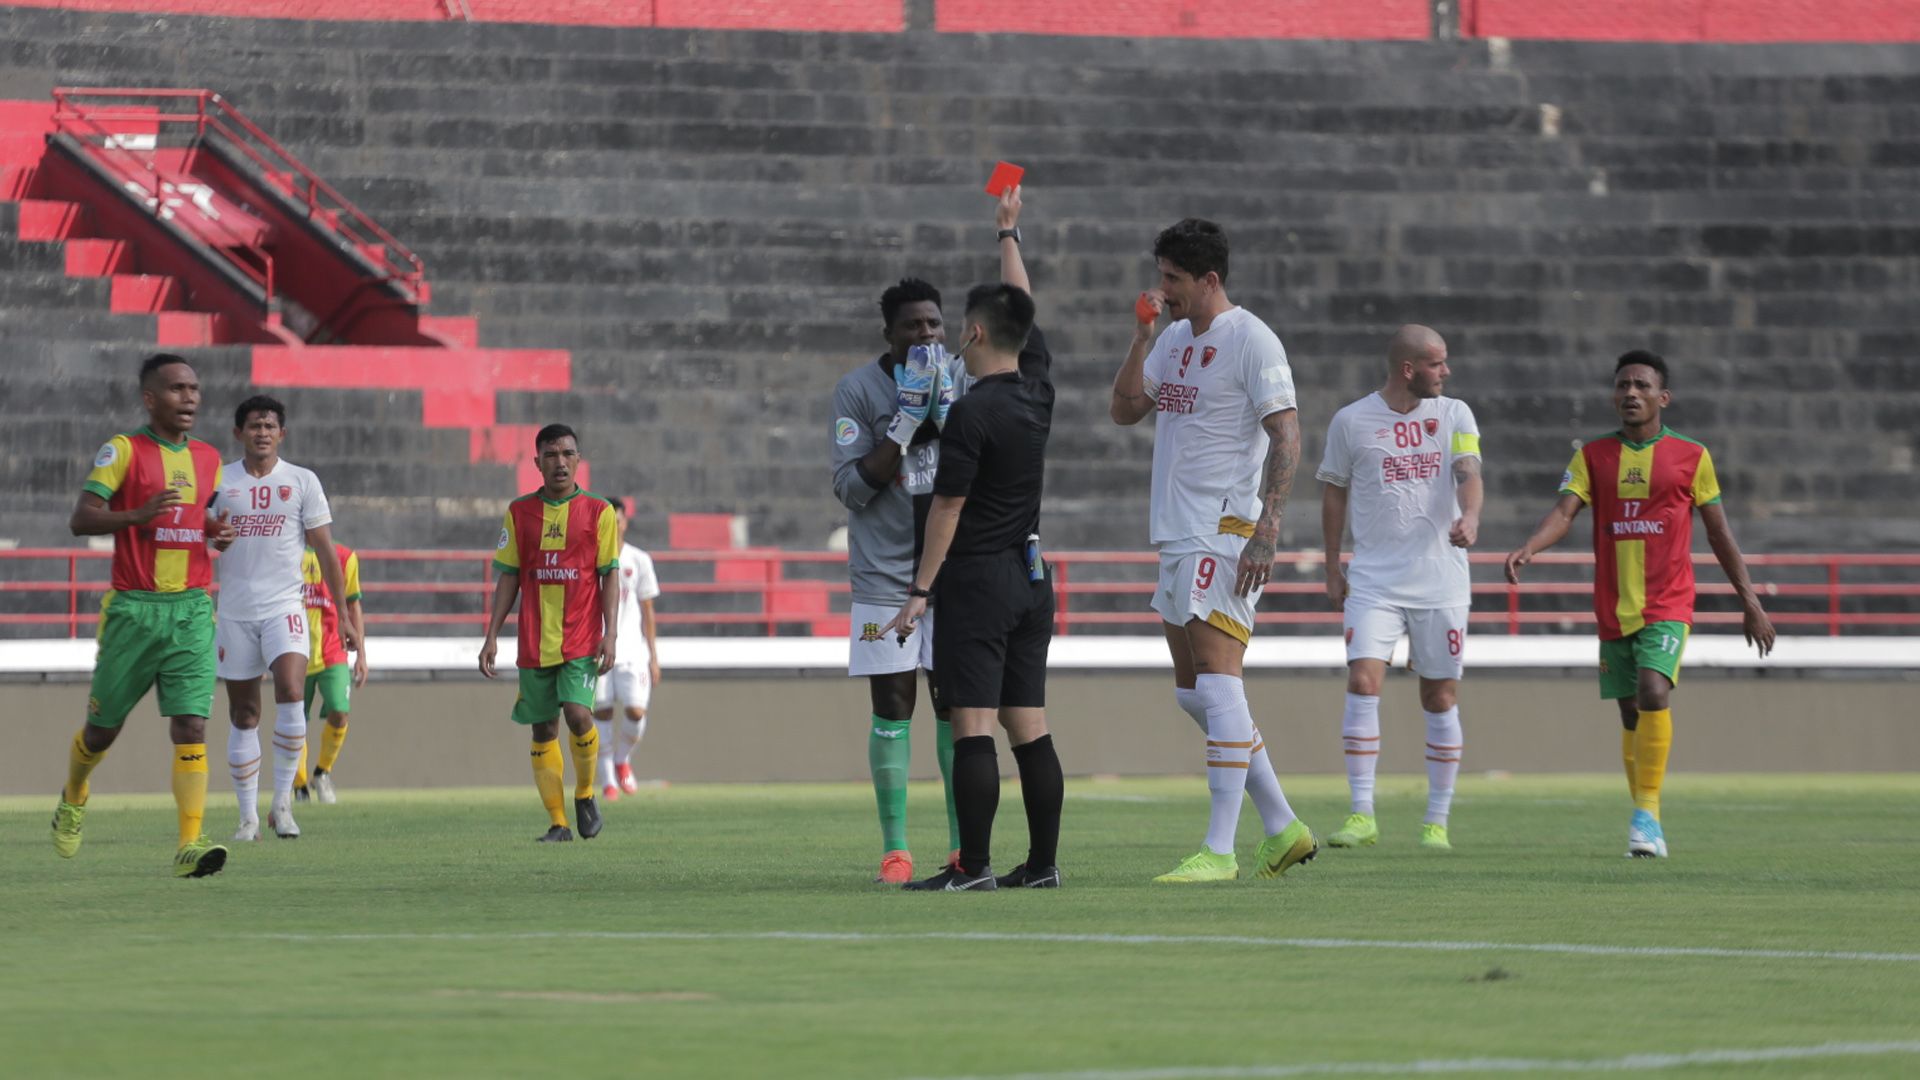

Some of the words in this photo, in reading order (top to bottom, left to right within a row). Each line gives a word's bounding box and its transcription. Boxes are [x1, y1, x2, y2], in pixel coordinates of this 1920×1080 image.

[1178, 345, 1194, 379] 9
[1393, 420, 1423, 449] 80
[918, 446, 935, 467] 30
[1382, 451, 1442, 470] BOSOWA
[1384, 464, 1441, 483] SEMEN
[248, 485, 271, 510] 19
[173, 506, 184, 524] 7
[1623, 502, 1640, 517] 17
[231, 514, 286, 525] BOSOWA
[1612, 520, 1664, 534] BINTANG
[155, 527, 204, 542] BINTANG
[545, 552, 558, 566] 14
[536, 568, 578, 580] BINTANG
[1195, 555, 1218, 591] 9
[285, 613, 304, 635] 19
[1661, 634, 1680, 655] 17
[583, 673, 596, 691] 14
